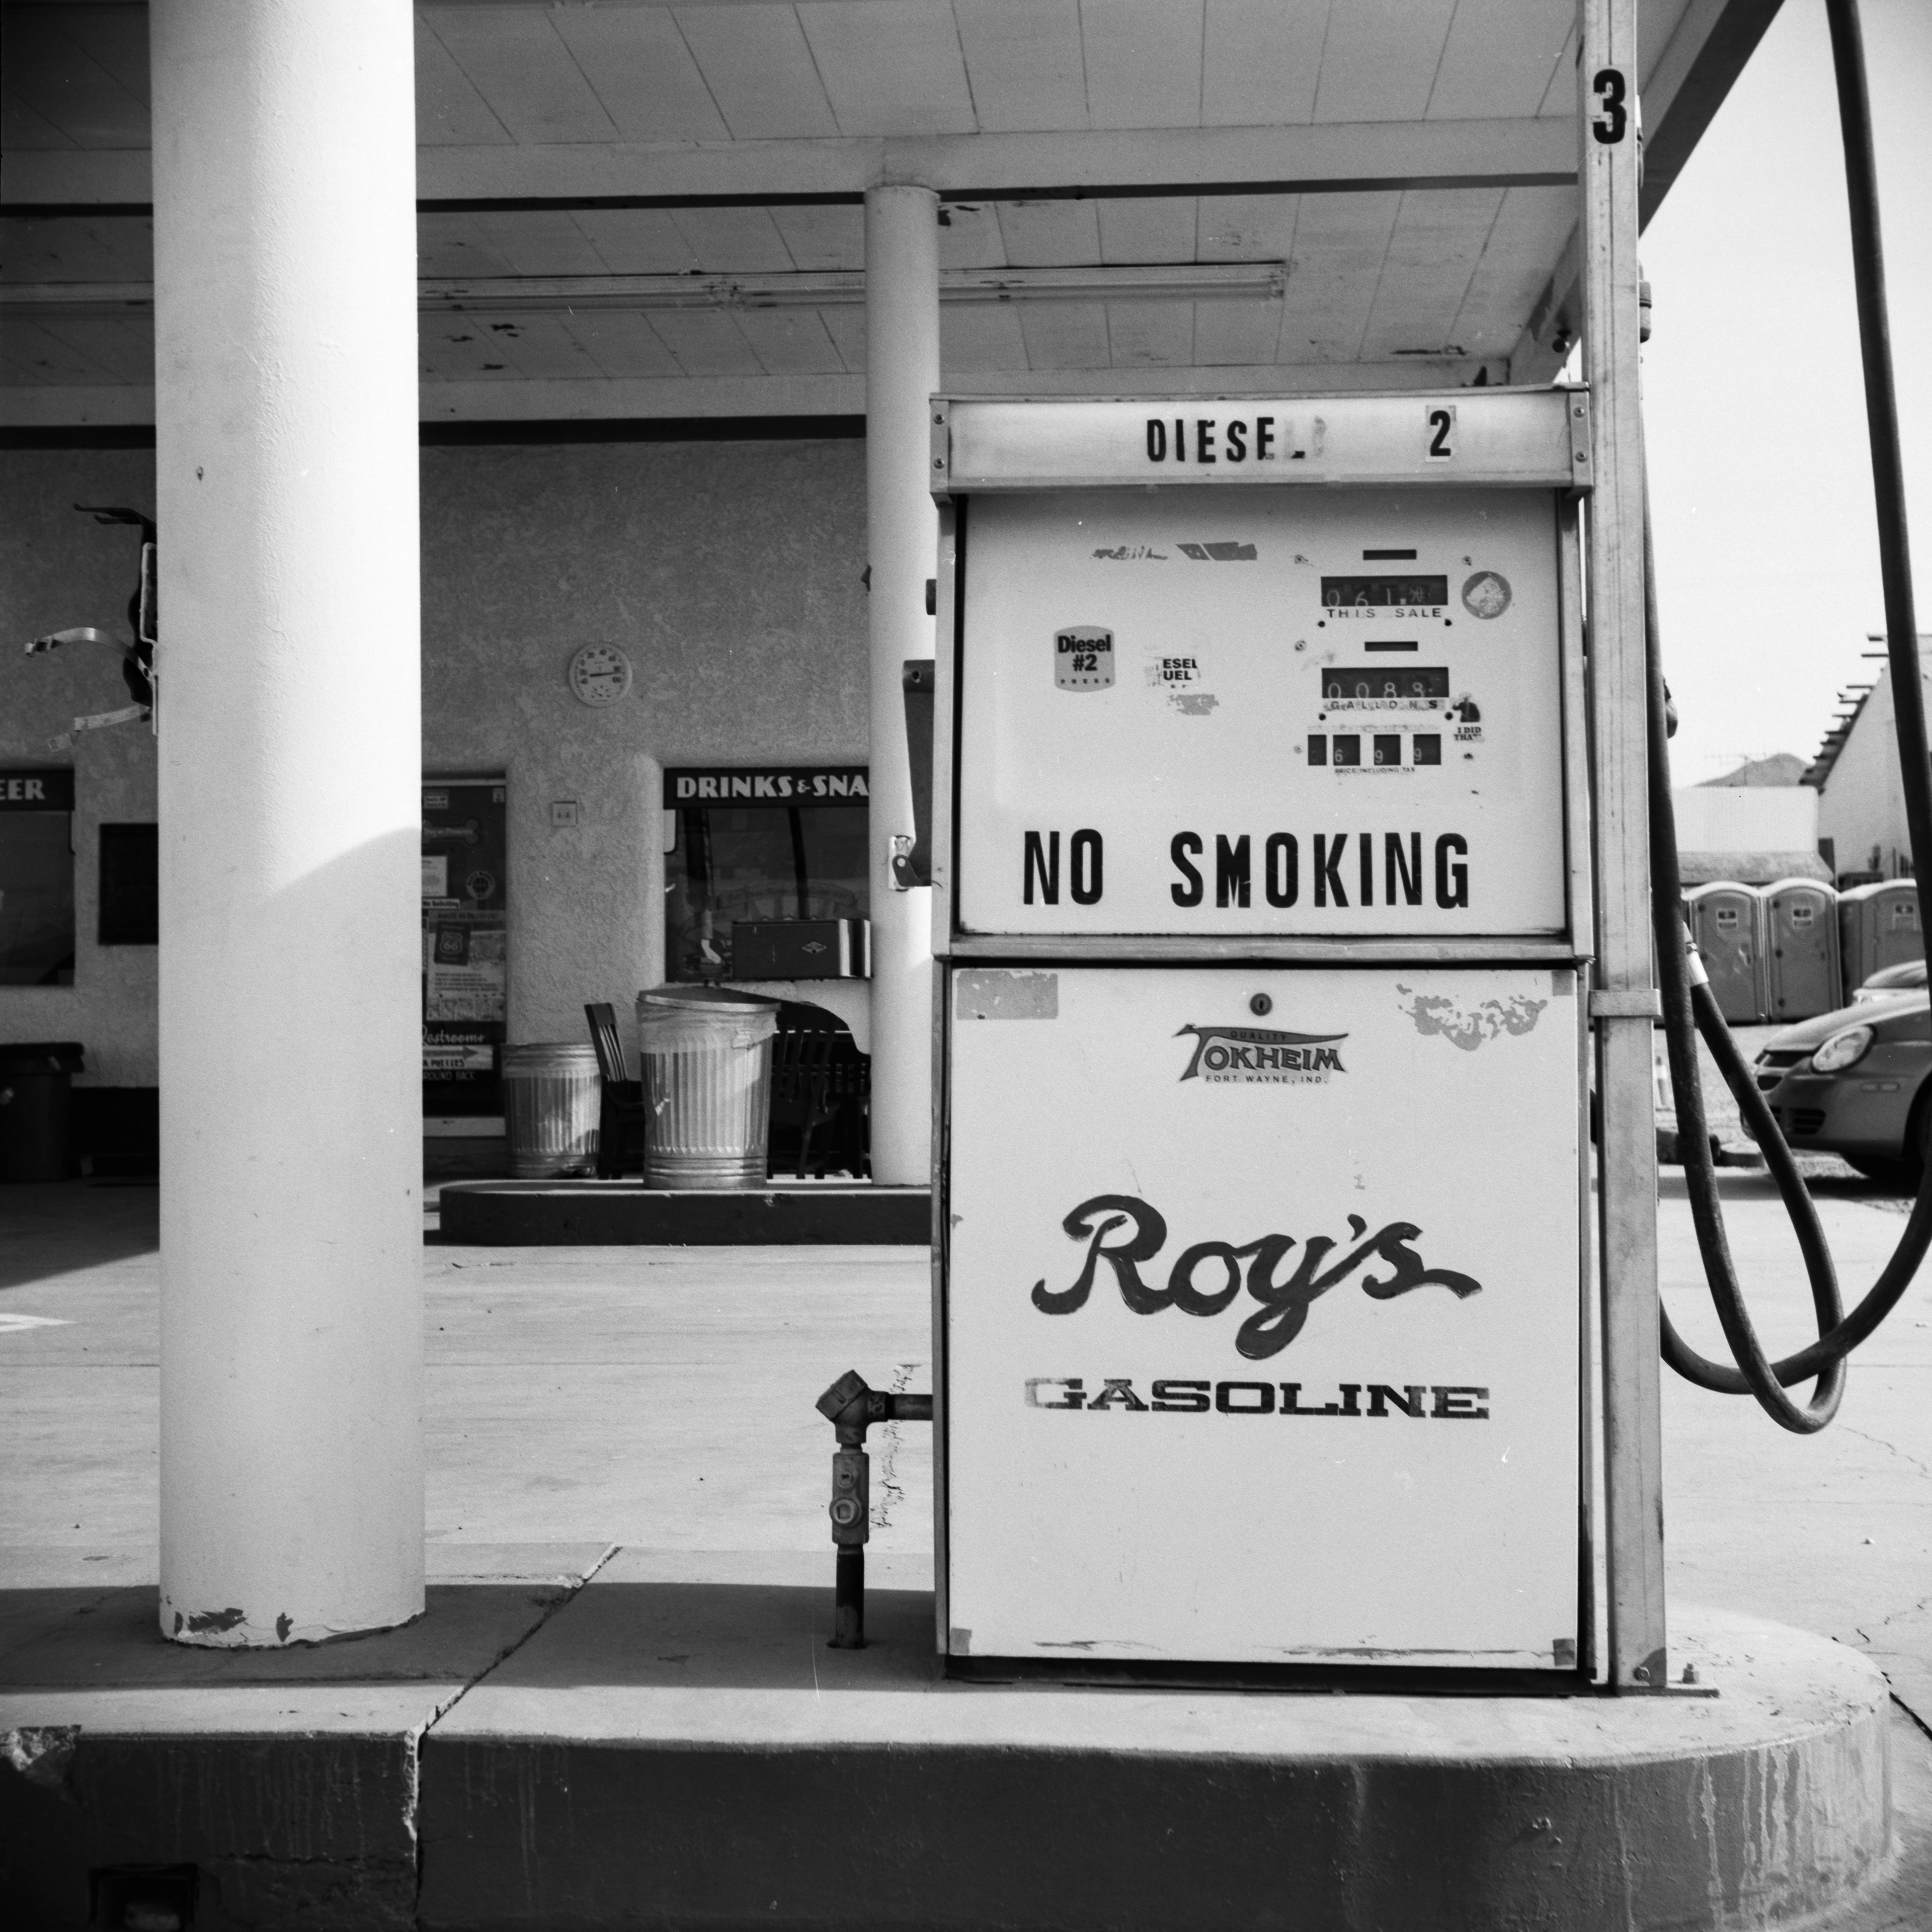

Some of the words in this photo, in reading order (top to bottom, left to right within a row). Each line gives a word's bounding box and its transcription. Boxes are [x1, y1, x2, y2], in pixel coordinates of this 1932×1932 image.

[1593, 68, 1627, 144] 3
[1430, 411, 1451, 456] 2
[1327, 609, 1376, 618] THIS
[1395, 608, 1441, 618] SALE
[1058, 634, 1111, 653] Diesel
[1072, 654, 1097, 671] #2
[1163, 670, 1192, 681] UEL
[1330, 700, 1438, 710] GALLONS
[677, 776, 792, 797] DRINKS
[1023, 829, 1103, 905] NO
[1170, 831, 1469, 909] SMOKING
[443, 940, 458, 951] 66
[1230, 1030, 1287, 1041] QUALITY
[1175, 1024, 1349, 1082] TOKHEIM
[1031, 1194, 1483, 1360] Roy's
[1024, 1378, 1490, 1419] GASOLINE
